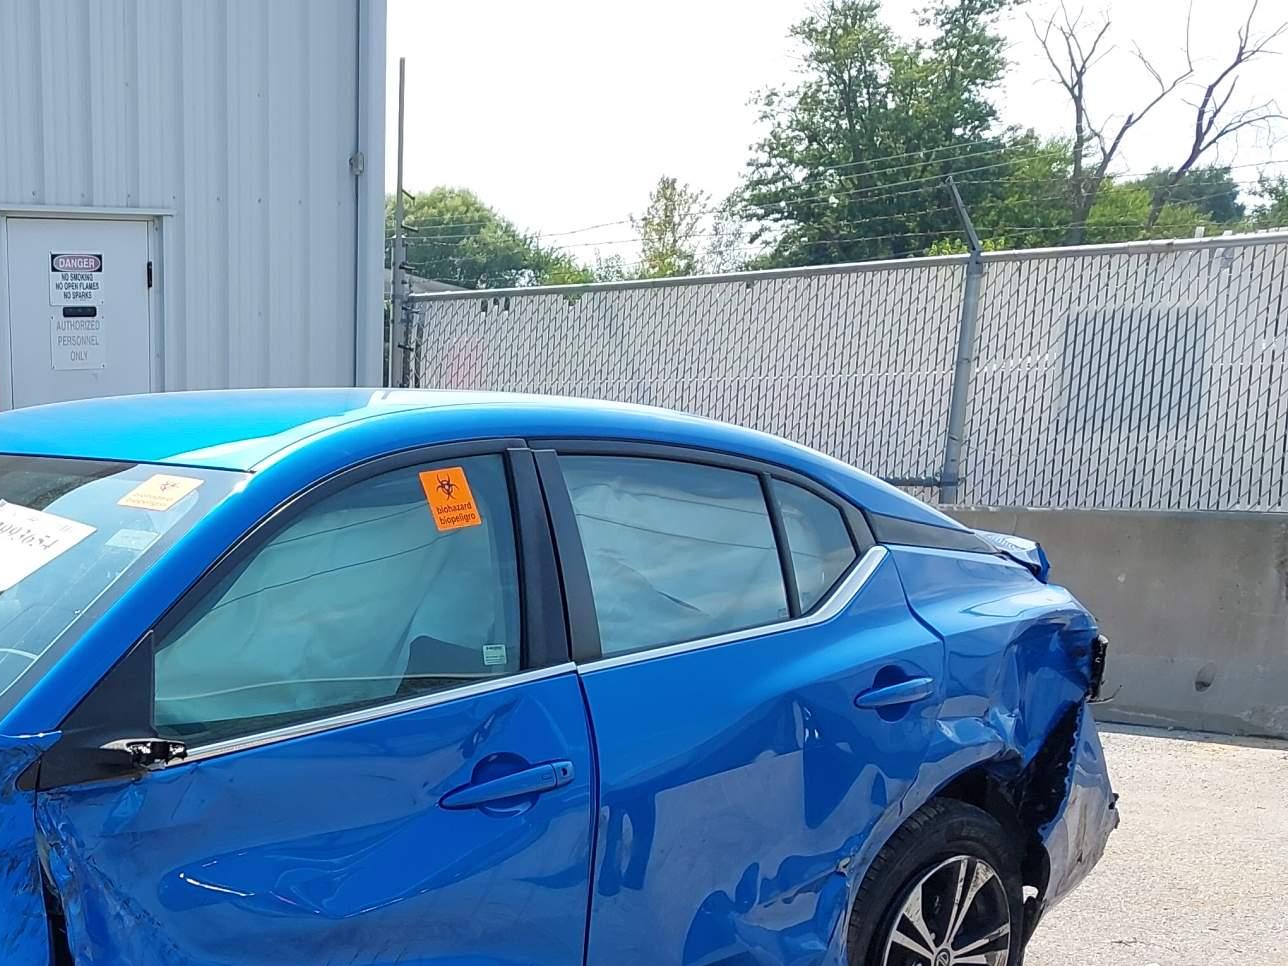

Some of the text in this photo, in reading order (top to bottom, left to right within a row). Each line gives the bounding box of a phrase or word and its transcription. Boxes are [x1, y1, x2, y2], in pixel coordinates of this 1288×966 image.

[58, 259, 95, 268] DANGER
[61, 273, 94, 281] NO SMOKING
[55, 282, 99, 290] NO OPEN FLAMES
[57, 321, 99, 331] AUTHORIZED
[58, 336, 98, 346] PERSONNEL
[71, 351, 88, 361] ONLY
[436, 502, 472, 514] biohazard
[439, 512, 476, 525] biopeligro
